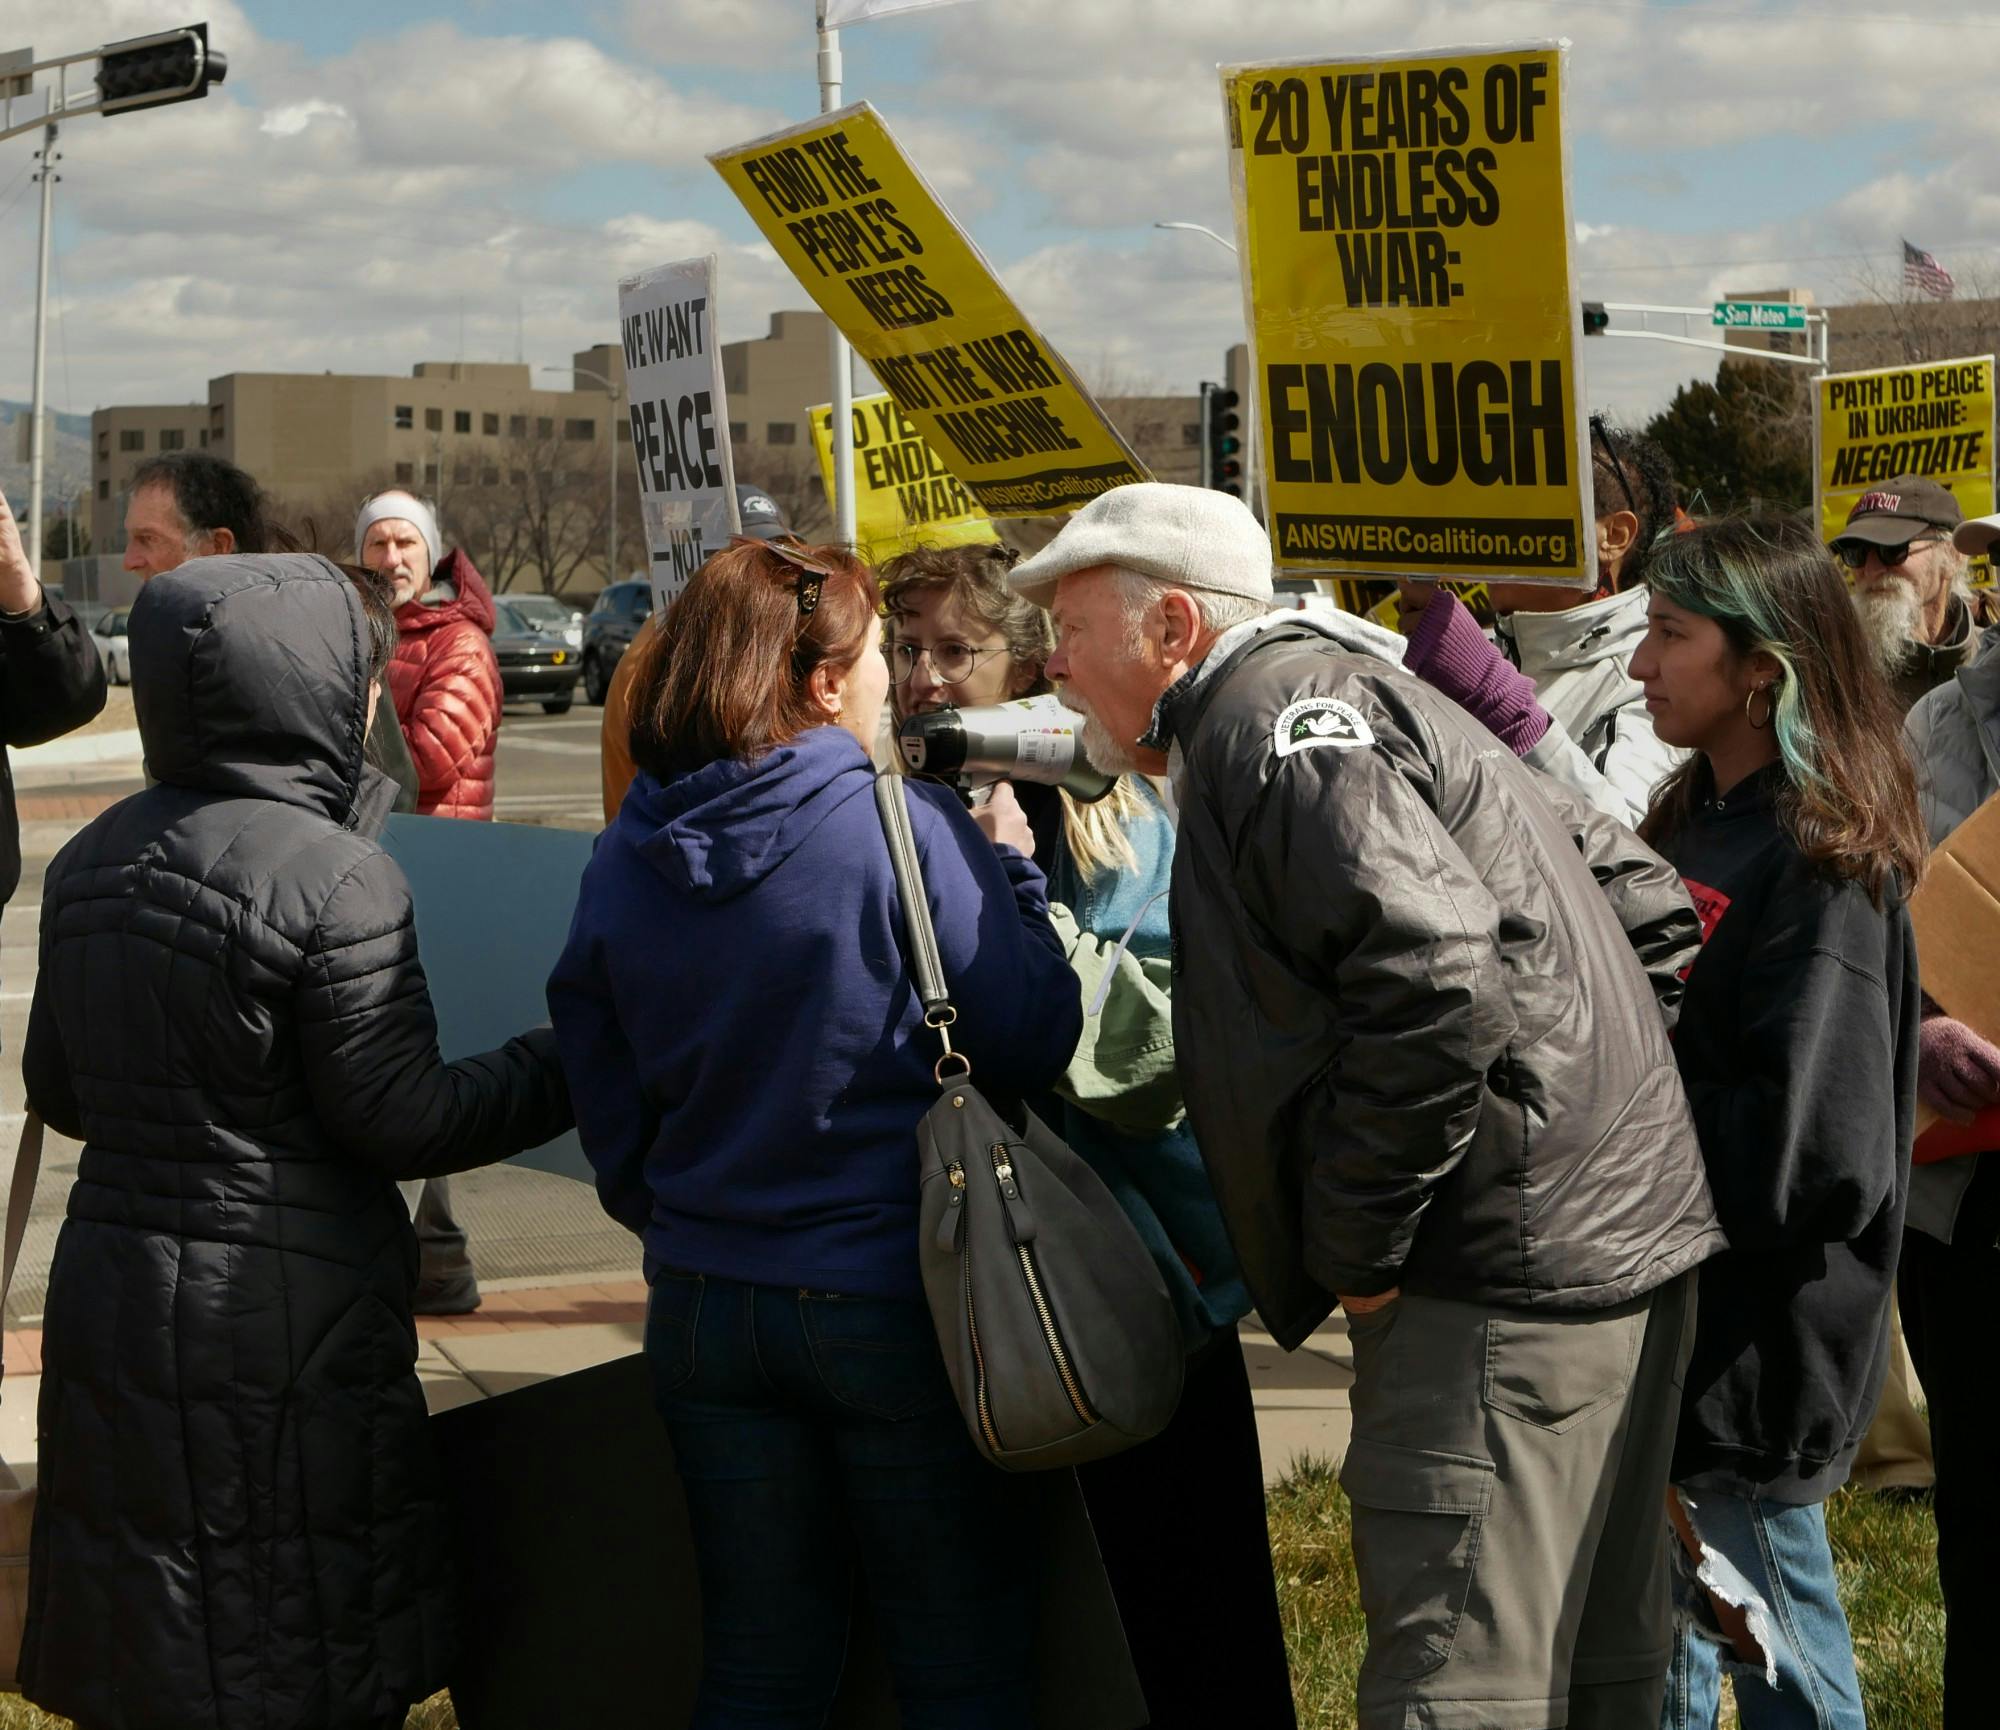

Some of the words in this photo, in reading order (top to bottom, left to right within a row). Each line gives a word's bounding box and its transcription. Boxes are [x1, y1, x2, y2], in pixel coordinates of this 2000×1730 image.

[1250, 78, 1309, 156] 20
[1320, 65, 1470, 152] YEARS
[1483, 62, 1548, 145] OF
[741, 147, 830, 218] FUND
[802, 131, 882, 201] THE
[1296, 147, 1500, 233] ENDLESS
[785, 198, 924, 278] PEOPLE'S
[1335, 230, 1464, 308] WAR:
[622, 314, 647, 370] WE
[645, 297, 706, 364] WANT
[845, 264, 955, 331] NEEDS
[1724, 303, 1749, 325] San
[1750, 304, 1785, 326] Mateo
[871, 354, 943, 411] NOT
[913, 345, 995, 406] THE
[962, 329, 1062, 395] WAR
[1829, 377, 1883, 411] PATH
[1889, 372, 1914, 403] TO
[1921, 365, 1984, 399] PEACE
[630, 391, 724, 493] PEACE
[933, 396, 1083, 465] MACHINE
[1267, 359, 1568, 487] ENOUGH
[1848, 410, 1869, 440] IN
[1875, 399, 1967, 436] UKRAINE:
[1830, 431, 1984, 487] NEGOTIATE
[1286, 522, 1566, 562] ANSWERCoalition.org
[1279, 702, 1313, 734] VETERANS
[1315, 702, 1334, 710] FOR
[1336, 705, 1362, 727] PEACE
